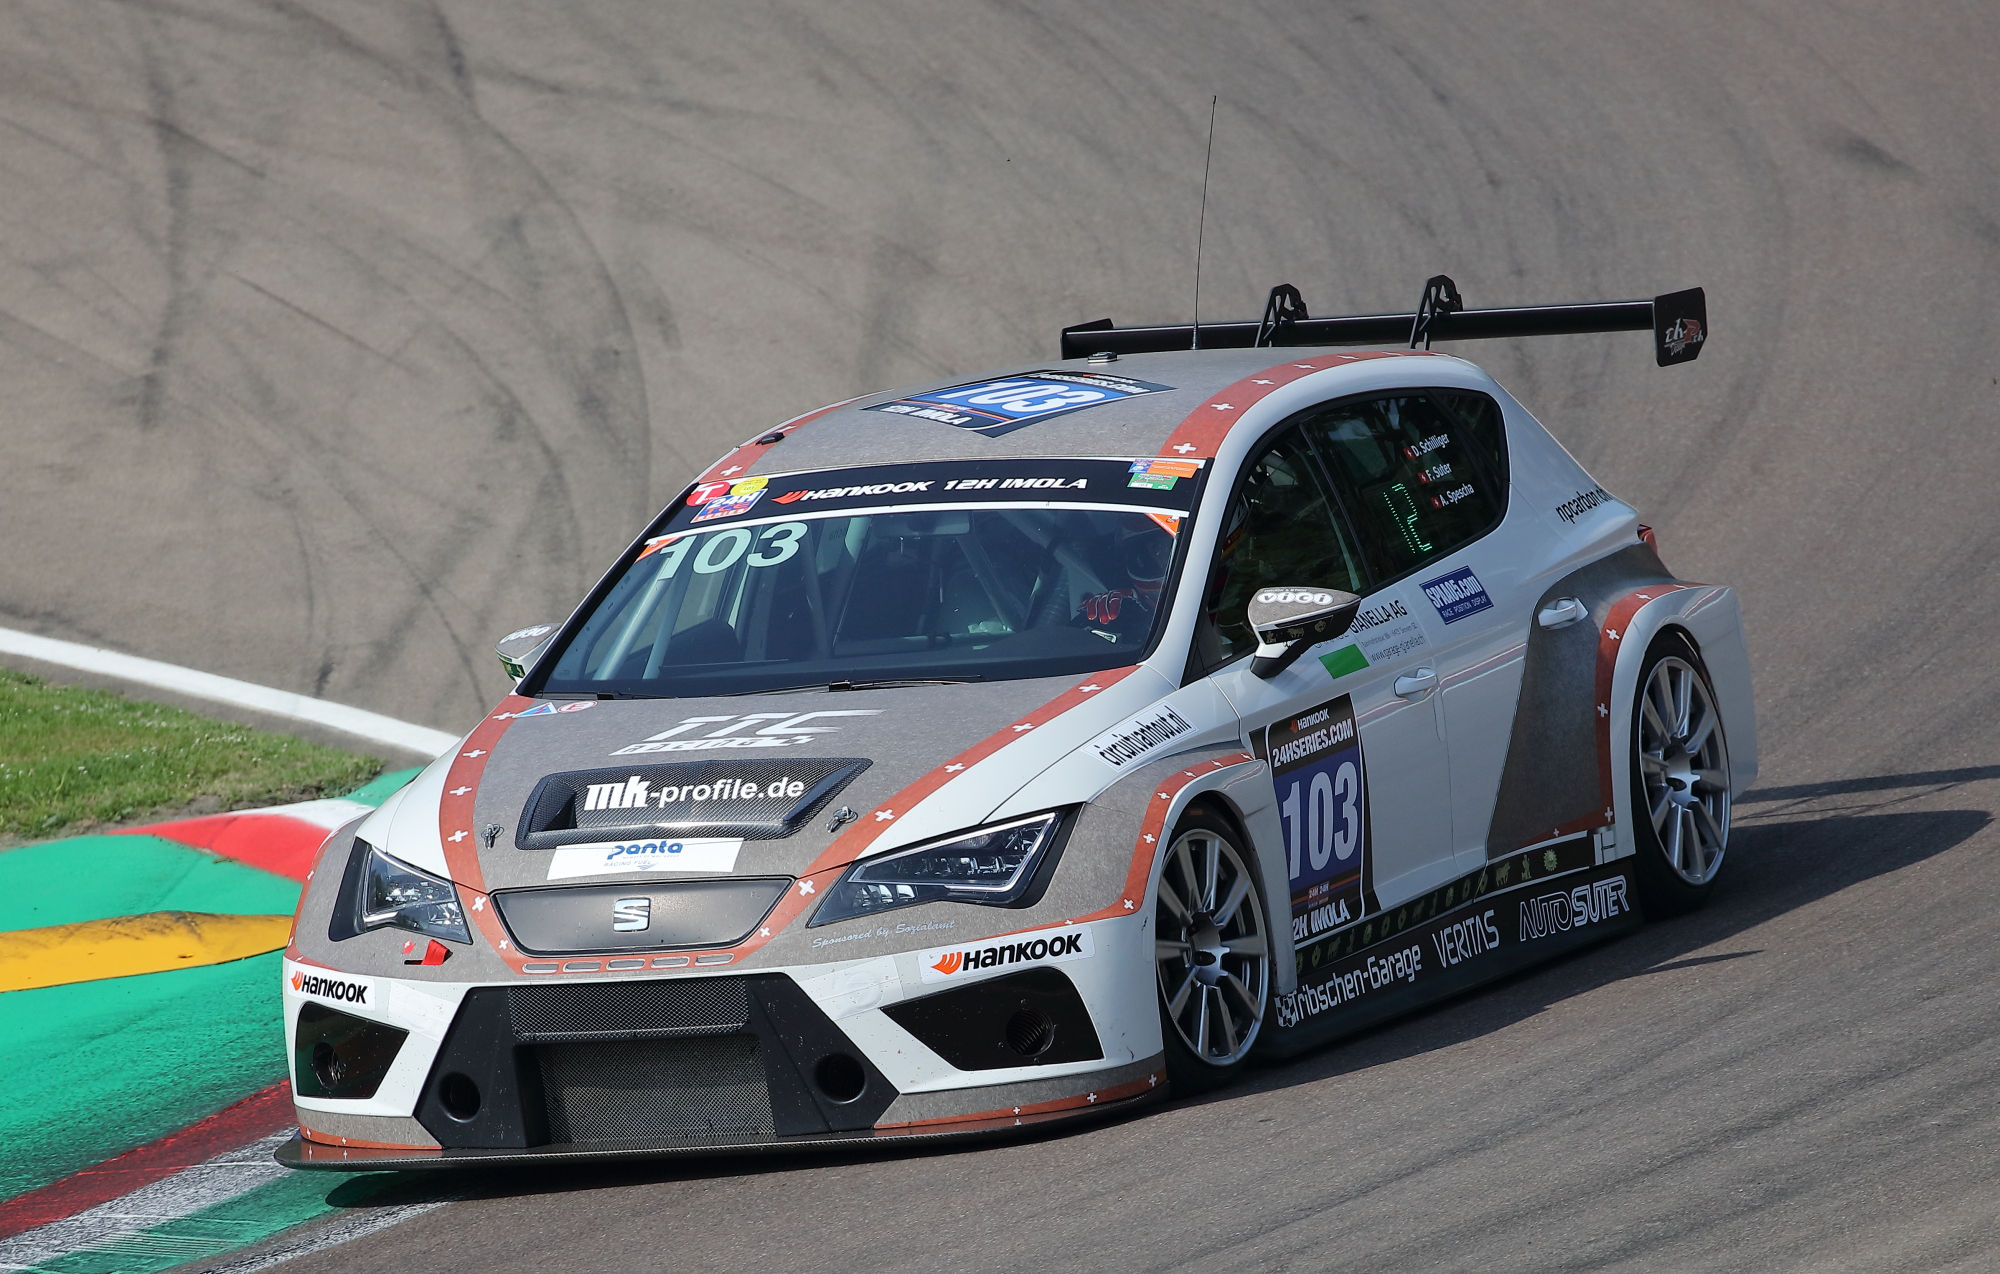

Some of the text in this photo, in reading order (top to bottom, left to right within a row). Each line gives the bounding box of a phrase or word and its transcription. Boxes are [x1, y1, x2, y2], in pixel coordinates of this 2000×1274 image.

[935, 380, 1106, 412] 103
[943, 478, 998, 491] 12H
[999, 478, 1088, 490] IMOLA
[1425, 463, 1452, 482] F. Suter
[658, 522, 808, 581] 103
[1389, 599, 1408, 618] AG
[1094, 705, 1192, 766] circuitvanhout.nl
[1273, 718, 1354, 768] 24HSERIES.COM
[584, 776, 804, 811] mk-profile.de
[1283, 761, 1358, 880] 103
[607, 840, 684, 860] panta
[1310, 898, 1351, 934] IMOLA
[812, 920, 956, 949] Sponsored by Sozialamt
[1287, 945, 1422, 1023] Tribschen-Garage
[1432, 910, 1500, 969] VERITAS
